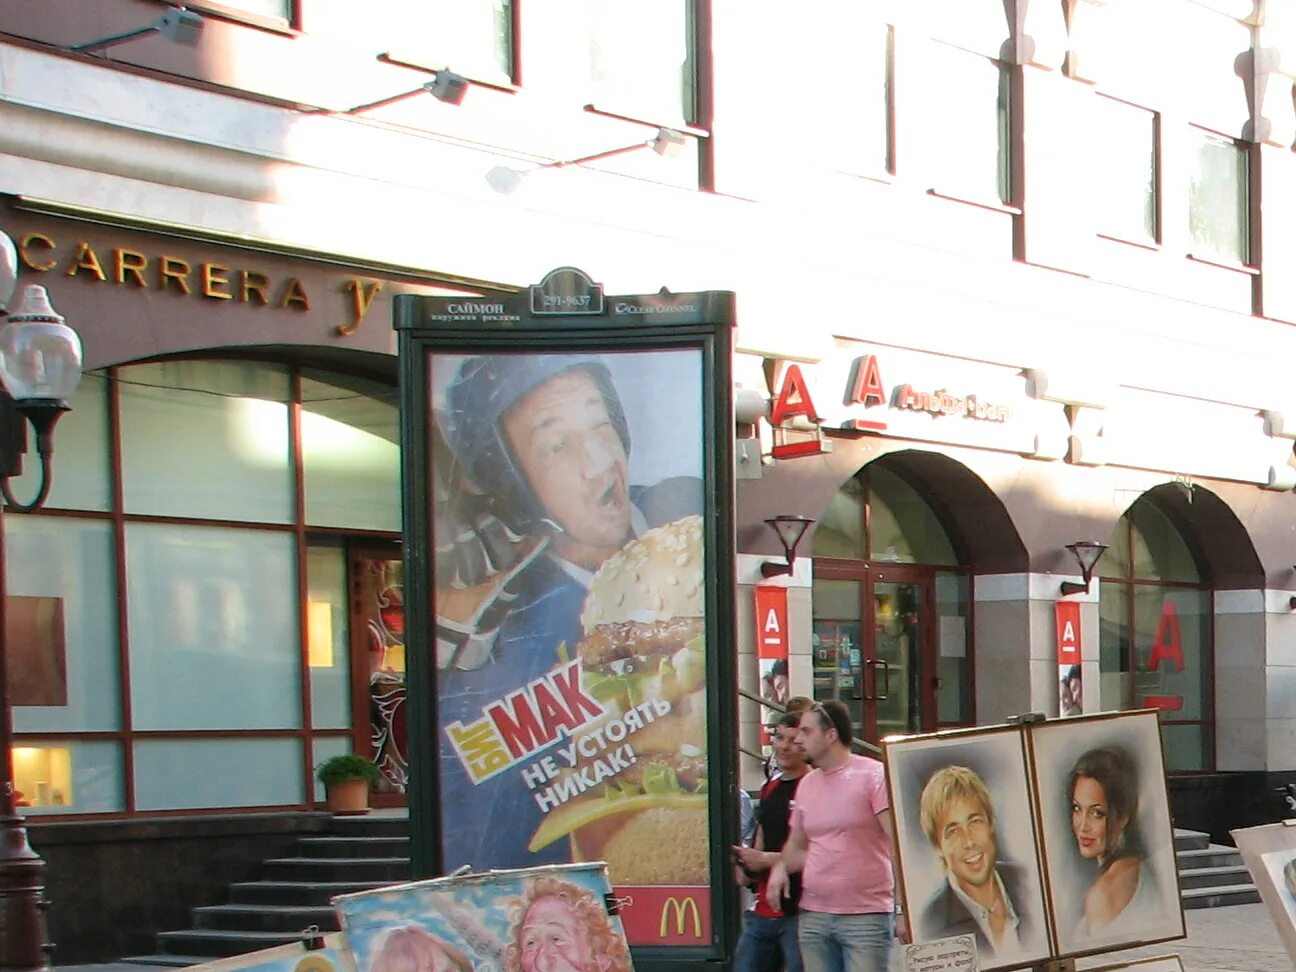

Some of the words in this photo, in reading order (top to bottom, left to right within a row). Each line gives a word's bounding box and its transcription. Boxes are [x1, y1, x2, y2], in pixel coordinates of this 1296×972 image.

[19, 232, 310, 311] CARRERA
[447, 302, 504, 314] САЙМОН
[451, 720, 511, 779] БИГ
[487, 666, 603, 760] МАК
[521, 756, 562, 790] НЕ
[560, 698, 673, 767] УСТОЯТЬ
[534, 745, 638, 813] НИКАК!
